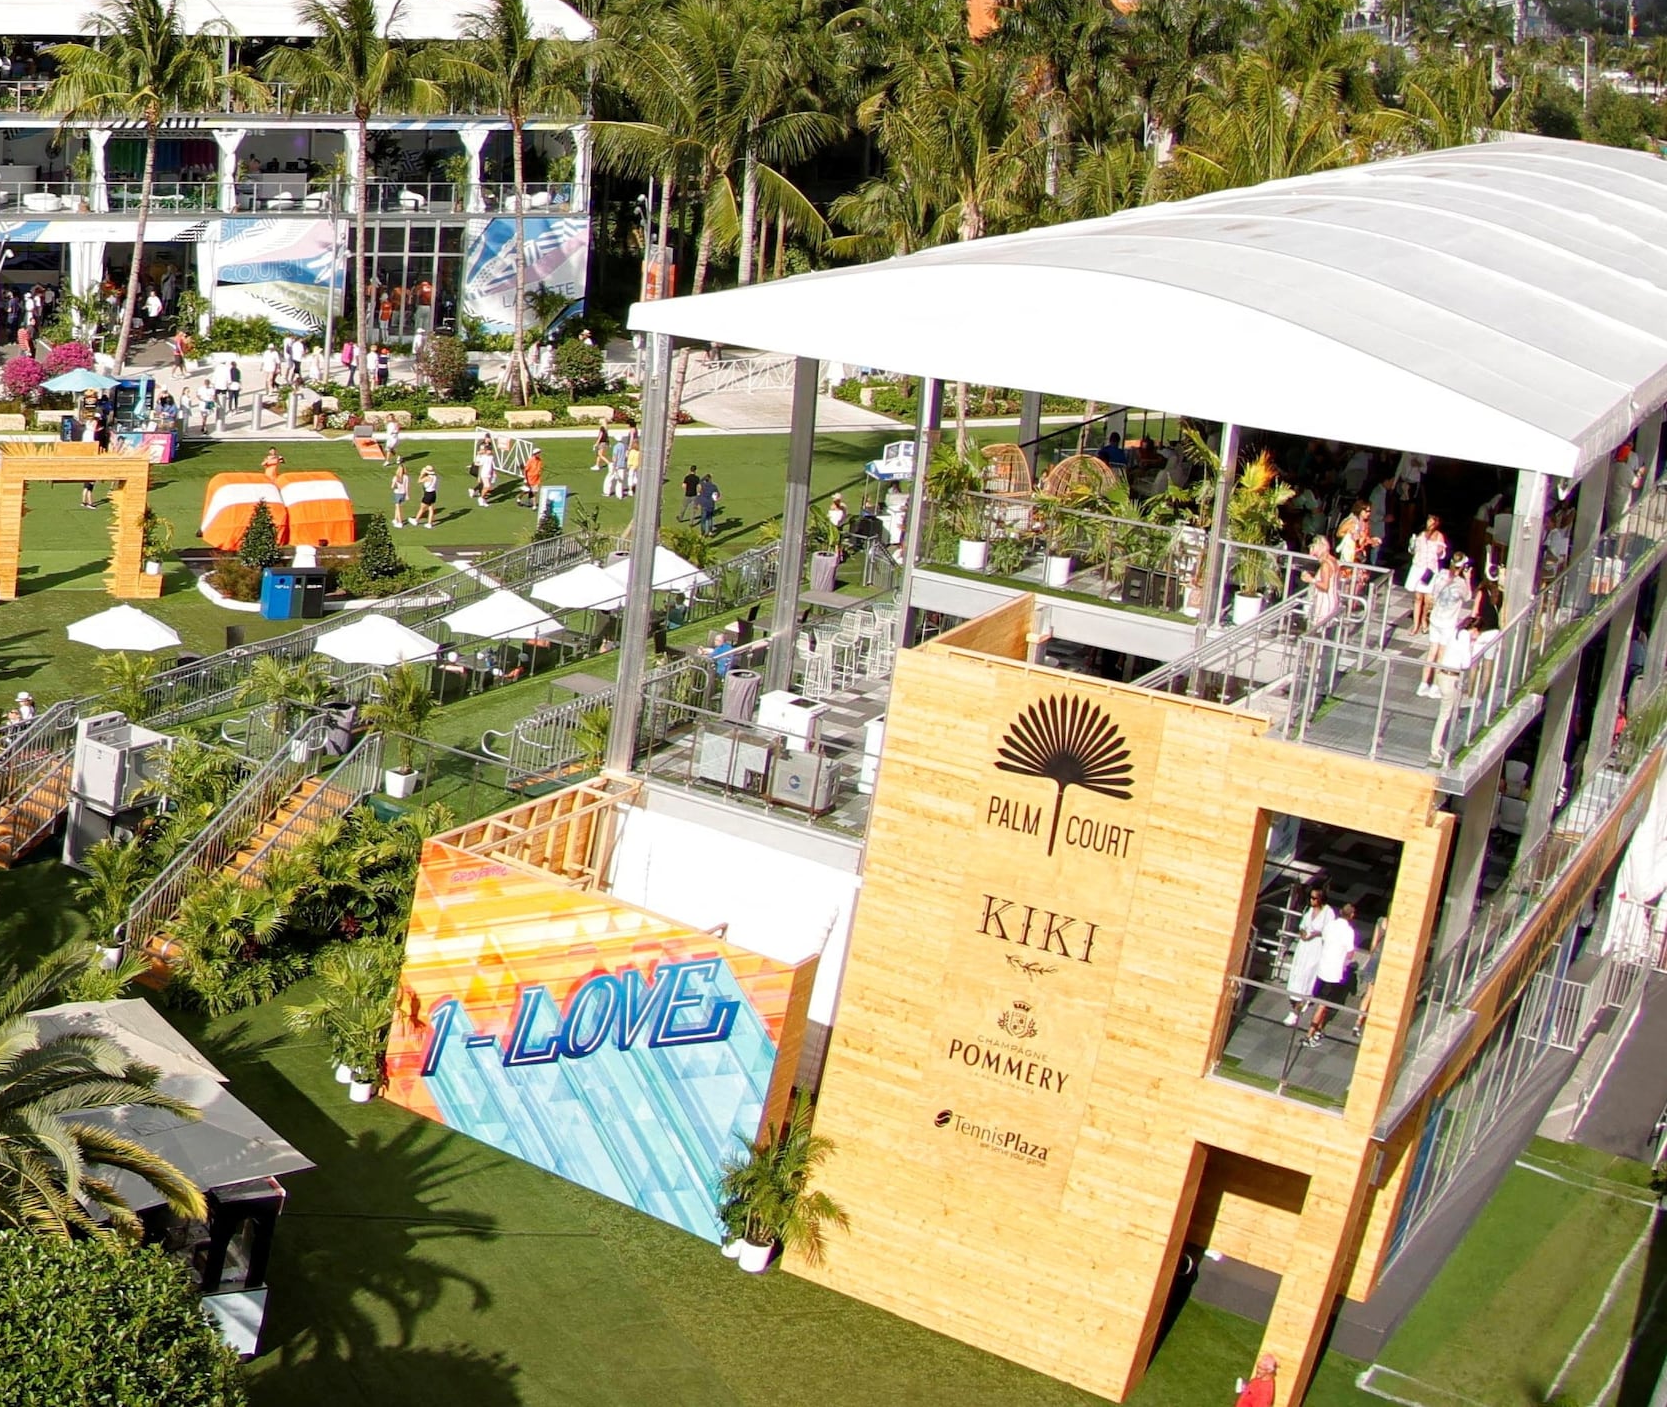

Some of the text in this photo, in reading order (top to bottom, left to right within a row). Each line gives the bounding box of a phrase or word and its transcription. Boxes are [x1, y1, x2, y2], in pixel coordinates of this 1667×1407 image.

[986, 795, 1136, 859] PALM COURT
[975, 893, 1102, 965] KIKI
[947, 1038, 1070, 1094] POMMERY
[977, 1034, 1049, 1063] CHAMPAGNE
[954, 1114, 1049, 1161] TennisPlaza
